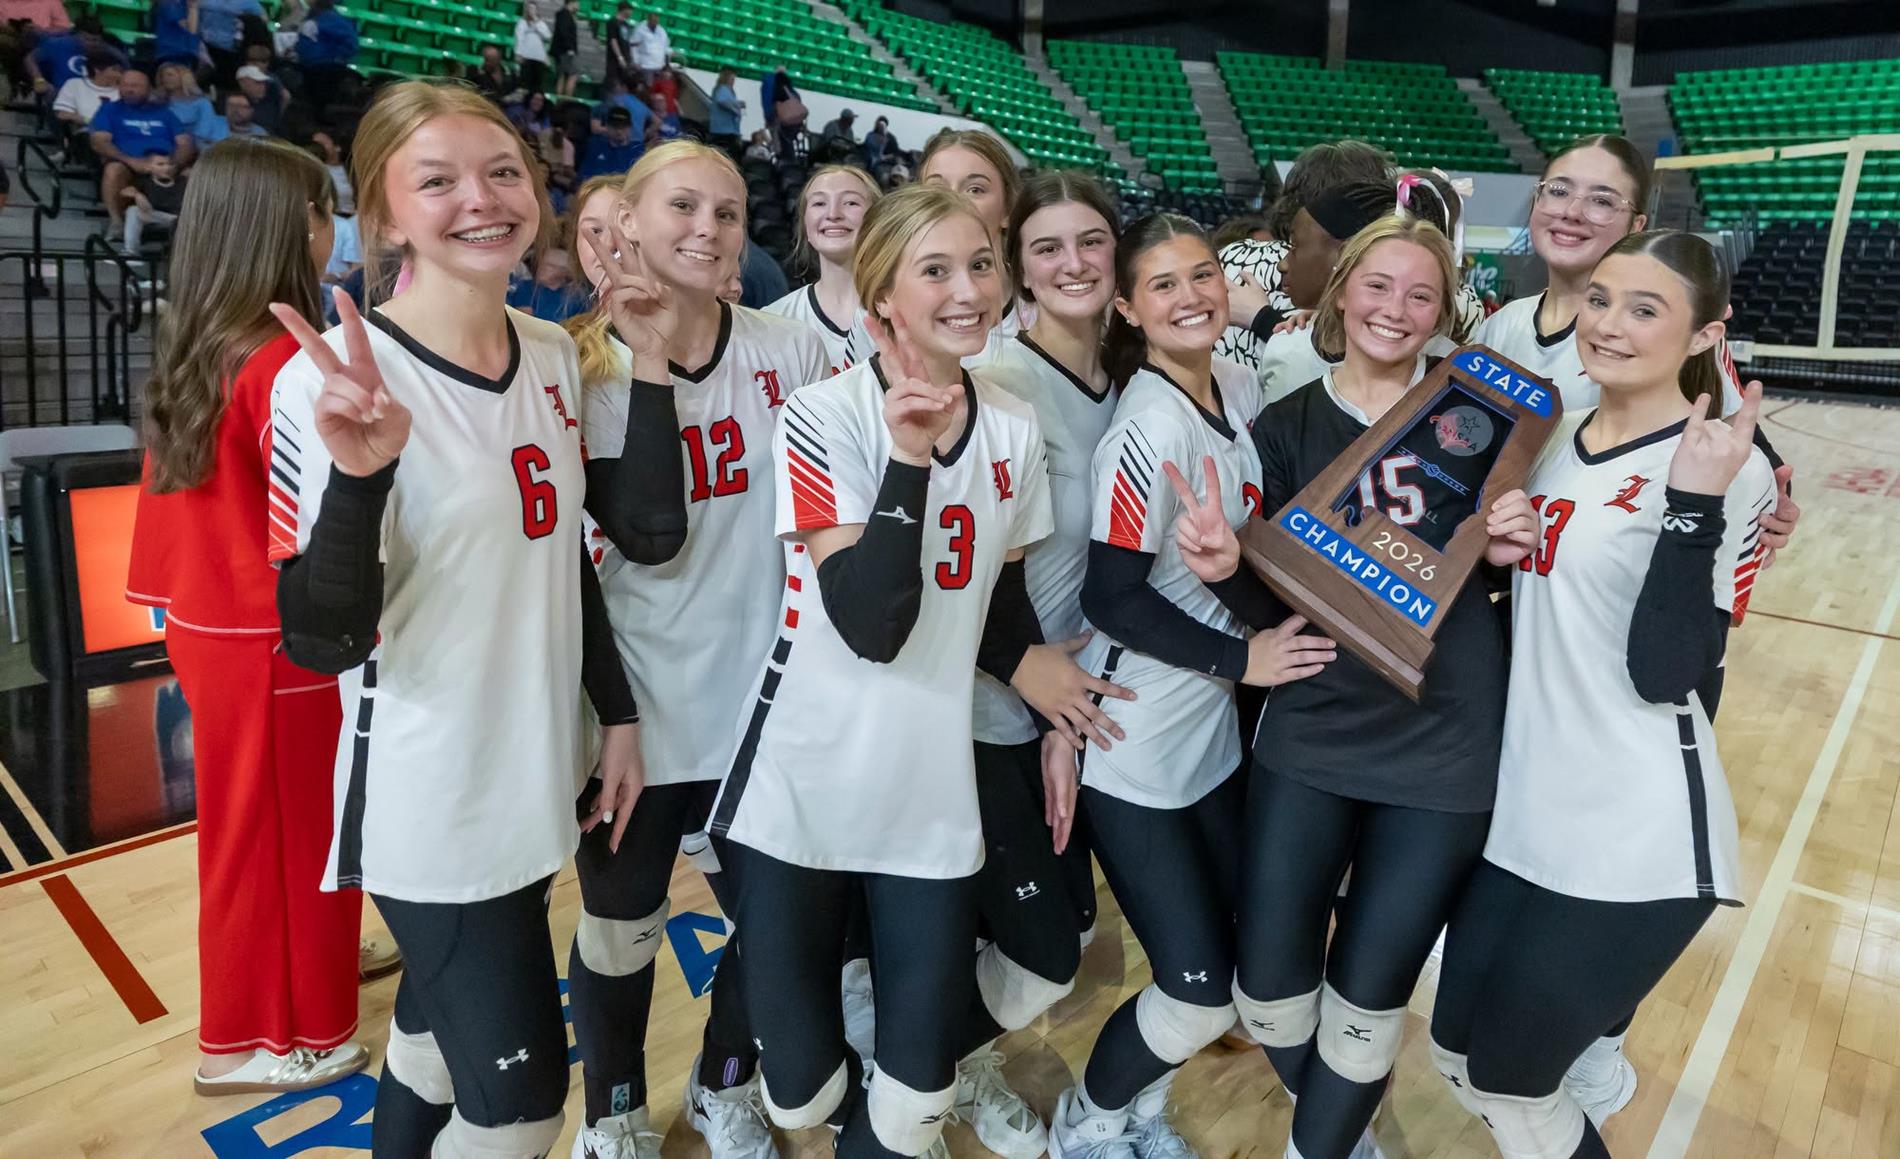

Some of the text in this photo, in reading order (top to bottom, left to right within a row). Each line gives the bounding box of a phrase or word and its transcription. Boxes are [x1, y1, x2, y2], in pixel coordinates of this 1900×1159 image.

[1466, 354, 1547, 410] STATE
[511, 443, 559, 541] 6
[680, 415, 749, 503] 12
[1358, 453, 1426, 527] 15
[935, 504, 976, 590] 3
[1288, 512, 1433, 623] CHAMPION
[1371, 530, 1438, 583] 2026
